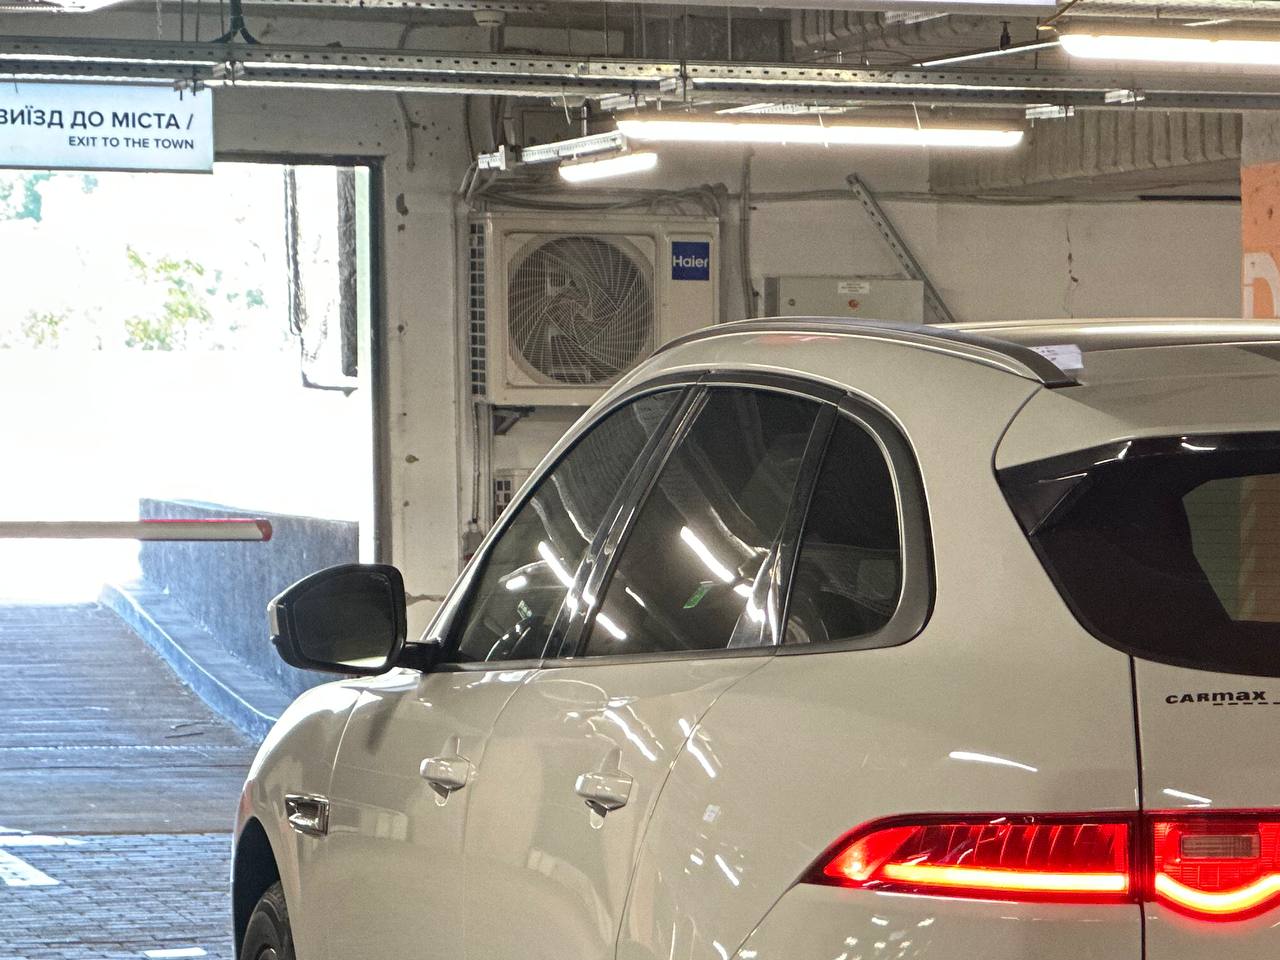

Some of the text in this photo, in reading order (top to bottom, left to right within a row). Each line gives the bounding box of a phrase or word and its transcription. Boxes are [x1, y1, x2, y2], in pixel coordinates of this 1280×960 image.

[70, 111, 104, 130] ДО
[112, 112, 180, 129] МІСТА
[69, 136, 194, 150] EXIT TO THE TOWN
[672, 255, 709, 268] Haier
